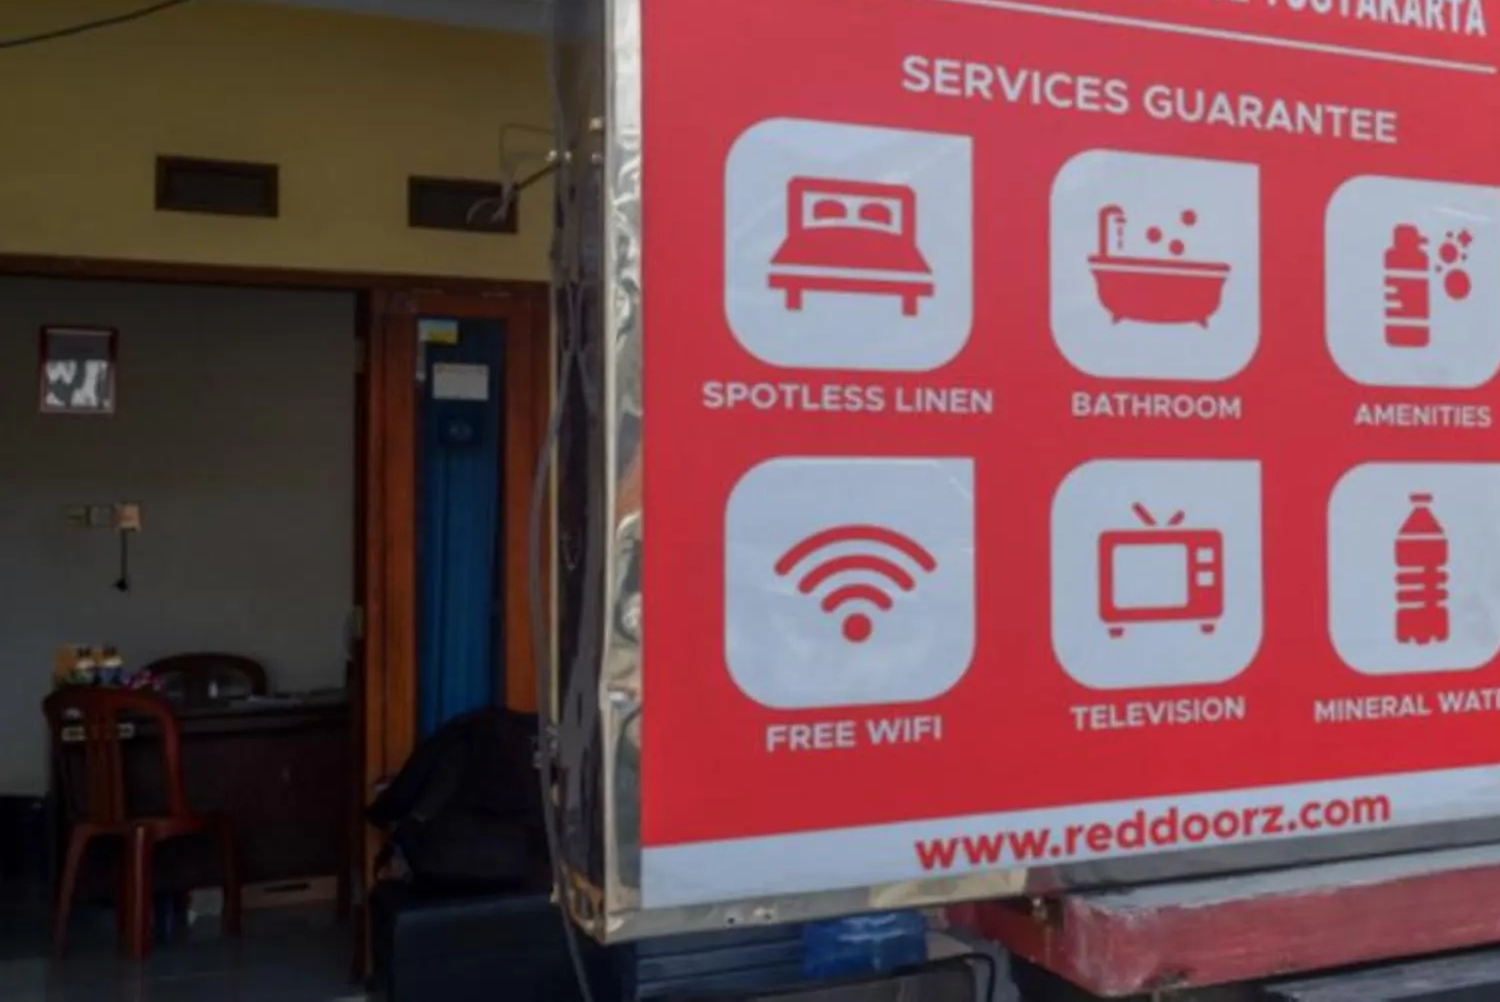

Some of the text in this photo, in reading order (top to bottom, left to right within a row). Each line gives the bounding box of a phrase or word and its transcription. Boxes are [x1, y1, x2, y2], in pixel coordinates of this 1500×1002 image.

[901, 54, 1398, 144] SERVICES GUARANTEE
[702, 380, 994, 414] SPOTLESS LINEN
[1071, 392, 1242, 420] BATHROOM
[1354, 403, 1491, 428] AMENITIES
[1071, 697, 1246, 731] TELEVISION
[1314, 695, 1431, 723] MINERAL
[766, 716, 942, 752] FREE WIFI
[916, 792, 1391, 869] www.reddoorz.com
